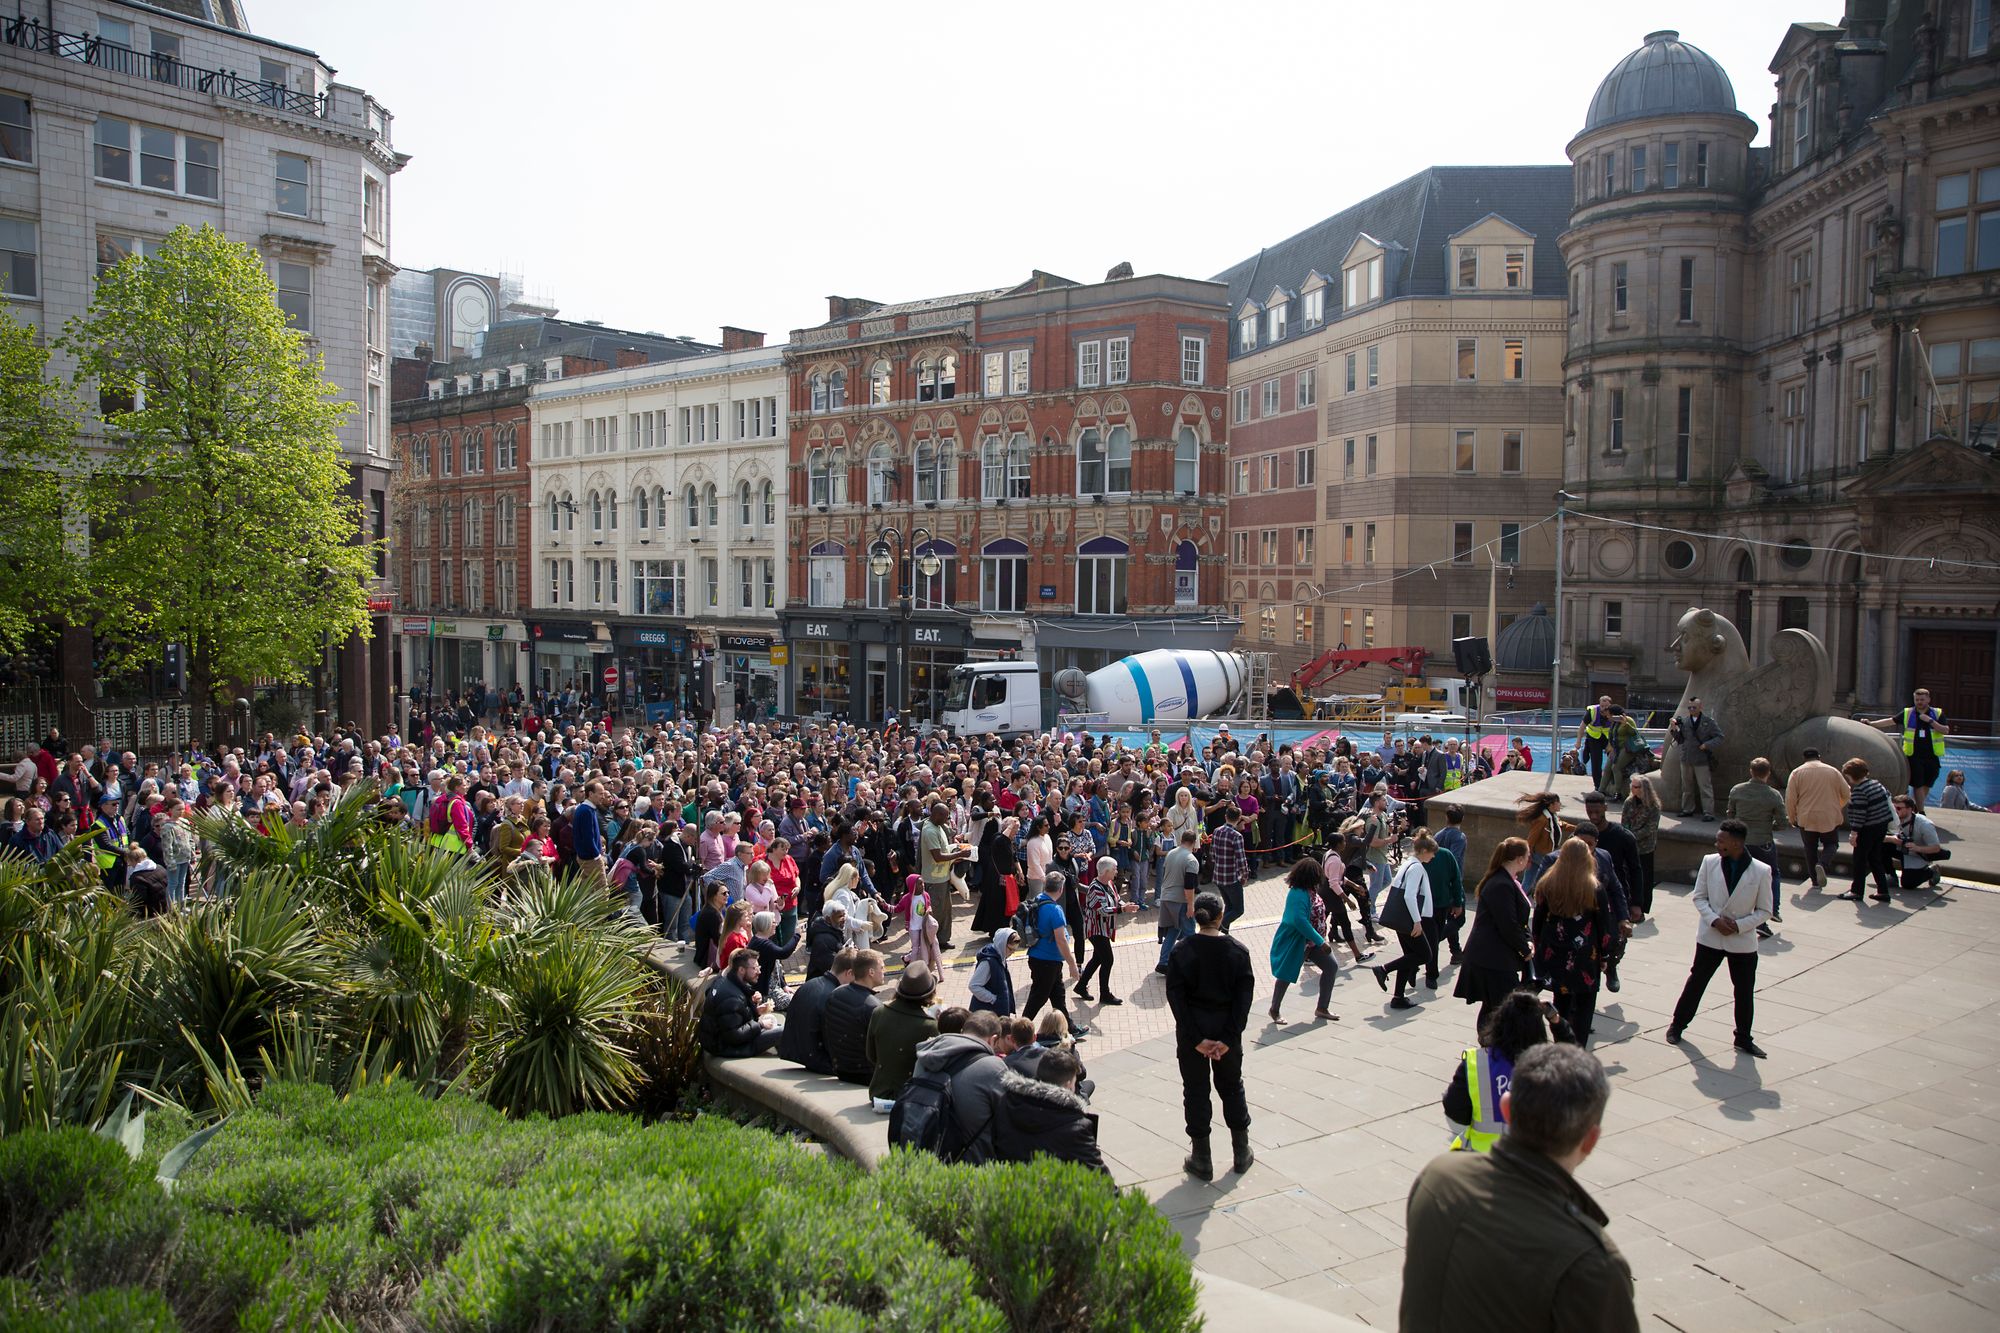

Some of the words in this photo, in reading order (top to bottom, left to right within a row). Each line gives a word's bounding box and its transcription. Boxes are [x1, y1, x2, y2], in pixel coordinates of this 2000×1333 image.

[443, 624, 457, 633] local
[806, 624, 830, 637] EAT.
[640, 632, 666, 643] GREGGS
[915, 629, 941, 642] EAT.
